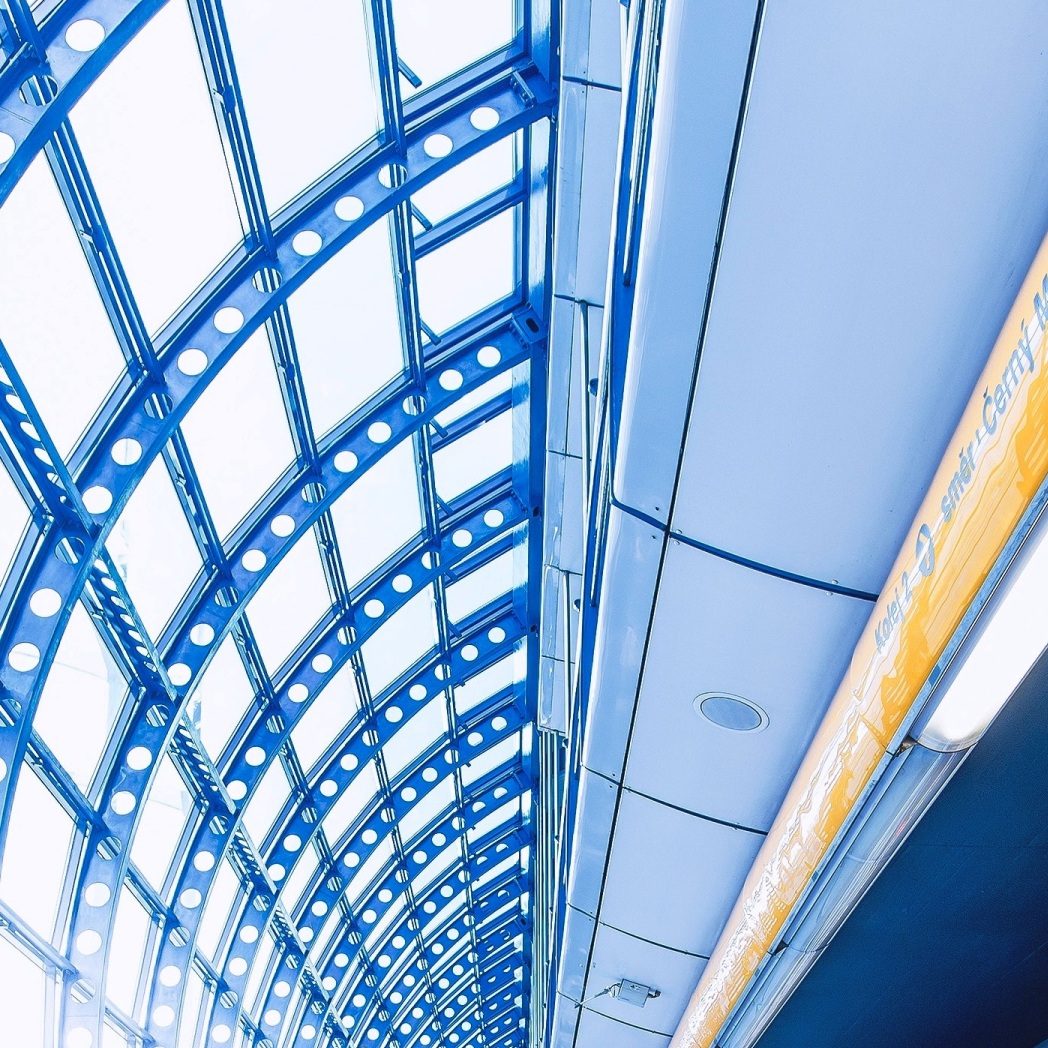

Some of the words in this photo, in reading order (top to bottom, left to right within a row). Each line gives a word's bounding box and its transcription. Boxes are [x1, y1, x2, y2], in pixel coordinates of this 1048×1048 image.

[875, 586, 906, 653] Kolej
[902, 571, 913, 598] 2
[982, 318, 1035, 435] Černý
